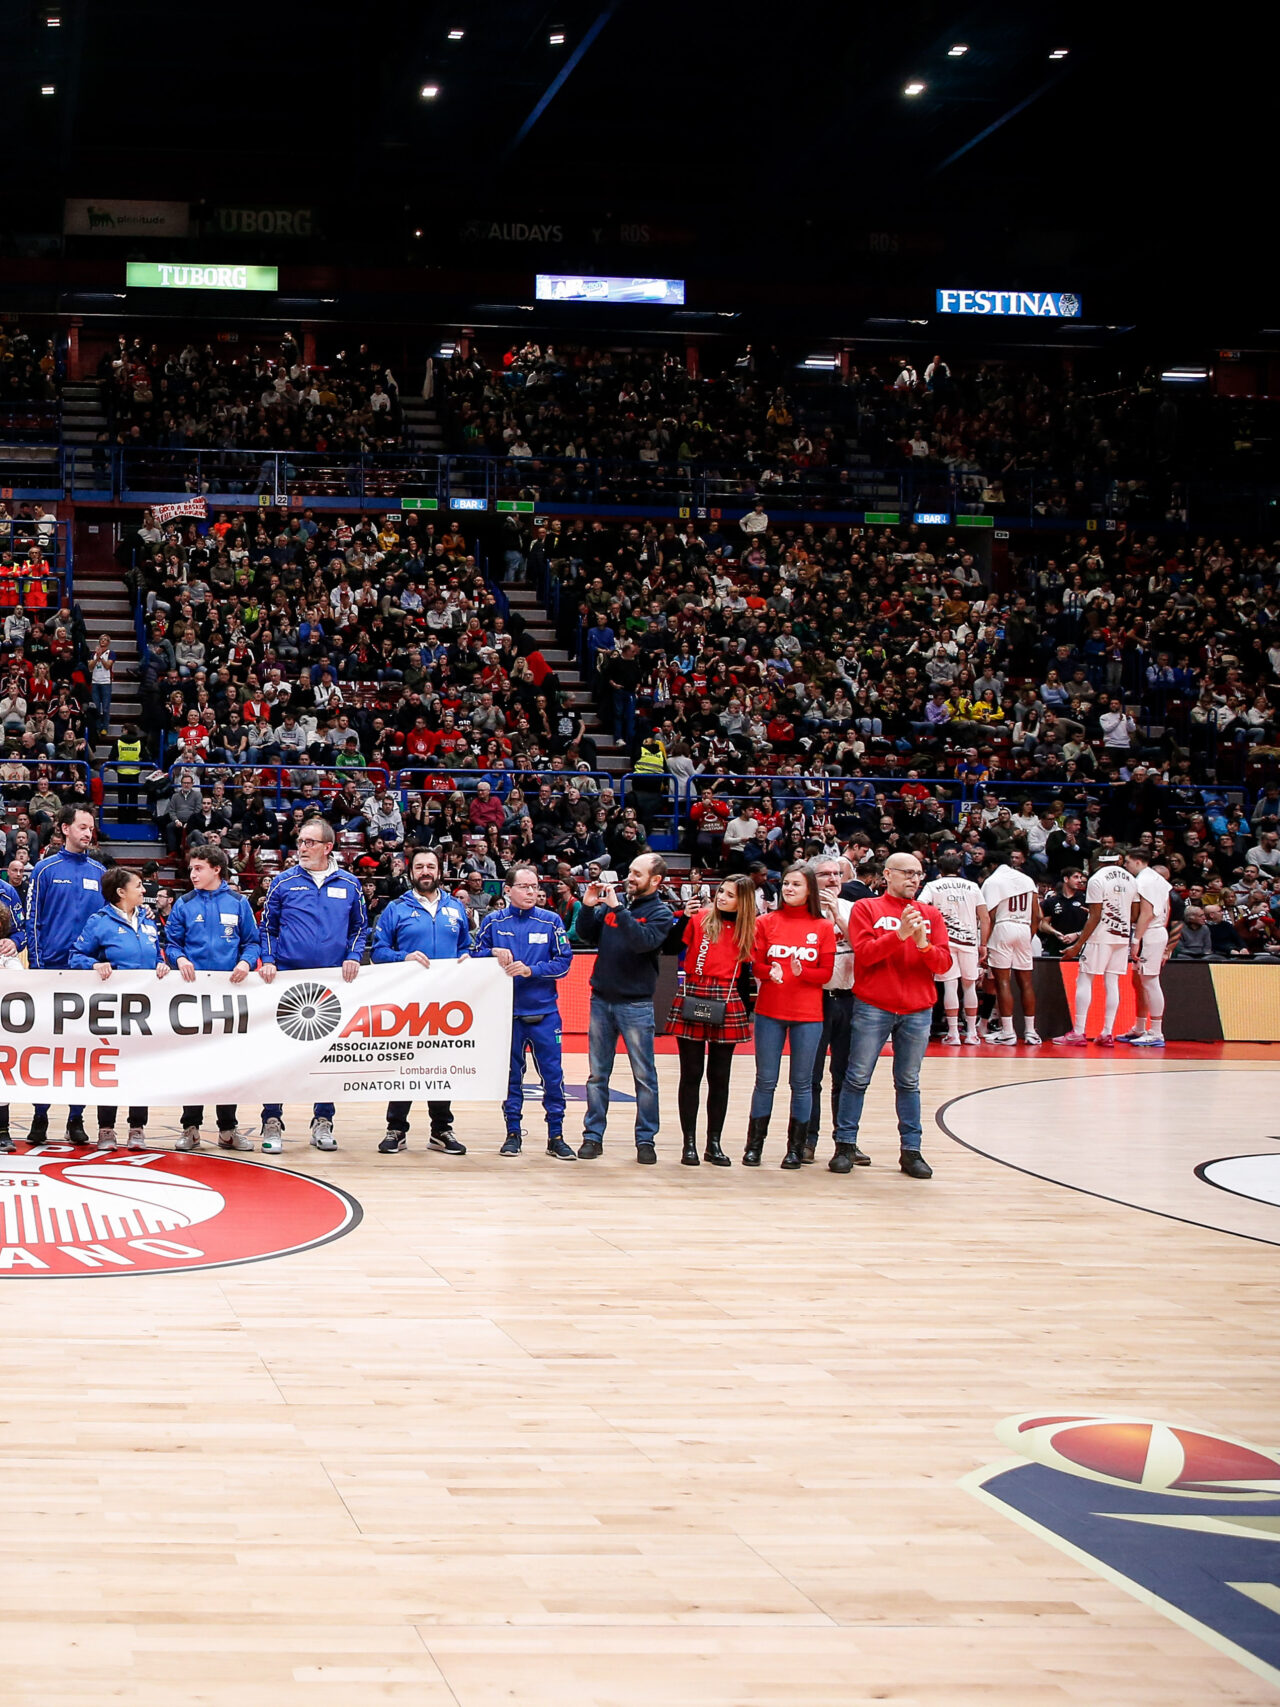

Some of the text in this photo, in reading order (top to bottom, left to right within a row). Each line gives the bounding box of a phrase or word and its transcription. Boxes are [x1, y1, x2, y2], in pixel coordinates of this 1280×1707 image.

[117, 215, 166, 225] plenitude
[212, 208, 312, 236] UBORG
[488, 222, 565, 243] ALIDAYS
[158, 265, 247, 289] TUBORG
[940, 290, 1059, 316] FESTINA
[460, 500, 478, 509] BAR
[923, 514, 941, 523] BAR
[767, 944, 818, 962] ADMO
[53, 992, 153, 1036] PER
[169, 993, 249, 1036] CHI
[338, 1000, 474, 1039] ADMO
[328, 1039, 476, 1052] ASSOCIAZIONE DONATORI
[320, 1052, 415, 1063] MIDOLLO OSSEO
[400, 1065, 477, 1076] Lombardia Onlus
[343, 1080, 452, 1092] DONATORI DI VITA
